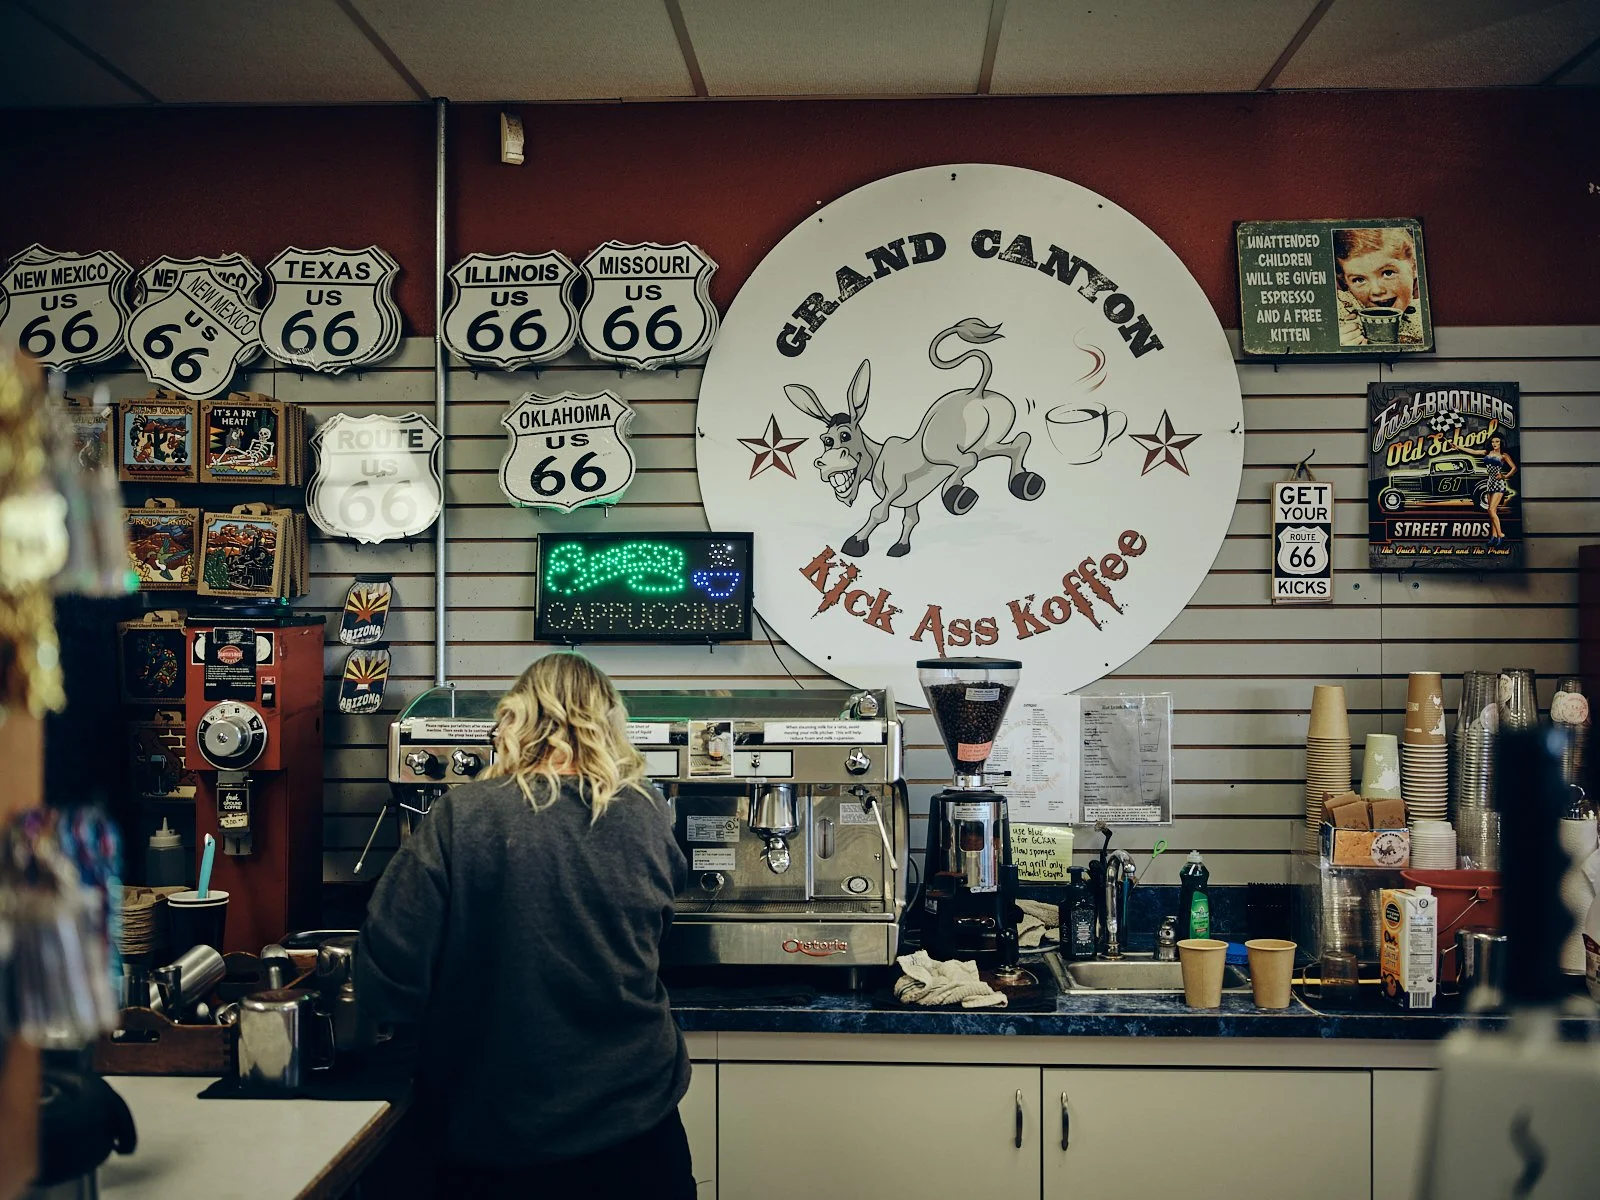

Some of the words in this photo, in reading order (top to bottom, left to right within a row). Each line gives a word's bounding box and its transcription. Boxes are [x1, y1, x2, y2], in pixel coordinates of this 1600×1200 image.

[1247, 234, 1320, 249] UNATTENDED
[599, 255, 691, 276] MISSOURI
[1257, 253, 1313, 267] CHILDREN
[14, 269, 47, 290] NEW
[51, 263, 108, 288] MEXICO
[152, 269, 178, 288] NE
[284, 260, 371, 280] TEXAS
[464, 263, 559, 284] ILLINOIS
[1245, 272, 1273, 286] WILL
[1276, 272, 1290, 285] BE
[1292, 271, 1327, 285] GIVEN
[306, 290, 343, 306] US
[490, 290, 529, 307] US
[625, 284, 663, 301] US
[775, 231, 948, 358] GRAND
[971, 229, 1165, 359] CANYON
[1260, 290, 1315, 305] ESPRESSO
[41, 293, 78, 312] US
[187, 275, 220, 304] NEW
[210, 295, 256, 336] MEXICO
[185, 309, 218, 341] US
[1256, 309, 1279, 324] AND
[1283, 309, 1292, 323] A
[1294, 309, 1322, 323] FREE
[19, 310, 98, 359] 66
[281, 310, 359, 357] 66
[466, 308, 547, 353] 66
[602, 304, 684, 353] 66
[1270, 328, 1311, 342] KITTEN
[143, 324, 210, 384] 66
[214, 409, 231, 417] IT'S
[233, 409, 240, 417] A
[241, 410, 257, 418] DRY
[222, 418, 248, 426] HEAT!
[518, 403, 611, 429] OKLAHOMA
[1372, 391, 1426, 453] Fast
[1425, 390, 1516, 429] BROTHERS
[337, 429, 423, 449] ROUTE
[545, 432, 590, 450] US
[1386, 435, 1426, 468] Old
[1427, 418, 1498, 457] School
[361, 459, 399, 477] US
[530, 451, 607, 497] 66
[1438, 477, 1462, 493] 61
[339, 480, 417, 529] 66
[1279, 486, 1328, 505] GET
[1280, 507, 1328, 520] YOUR
[1290, 533, 1316, 541] ROUTE
[1394, 522, 1448, 537] STREET
[1451, 522, 1491, 537] RODS
[1289, 546, 1316, 568] 66
[799, 544, 904, 636] Kick
[910, 604, 999, 659] Ass
[1006, 529, 1148, 641] Koffee
[1278, 581, 1327, 594] KICKS
[547, 601, 743, 631] CAPPUCCINO
[340, 625, 382, 643] ARIZONA
[339, 693, 381, 712] ARIZONA
[1012, 828, 1026, 836] use
[1027, 827, 1043, 837] blue
[1017, 836, 1028, 844] for
[1012, 846, 1028, 855] ellow
[1029, 848, 1056, 860] sponges
[1015, 858, 1028, 870] dog
[1029, 859, 1047, 872] grill
[1049, 861, 1066, 873] only.
